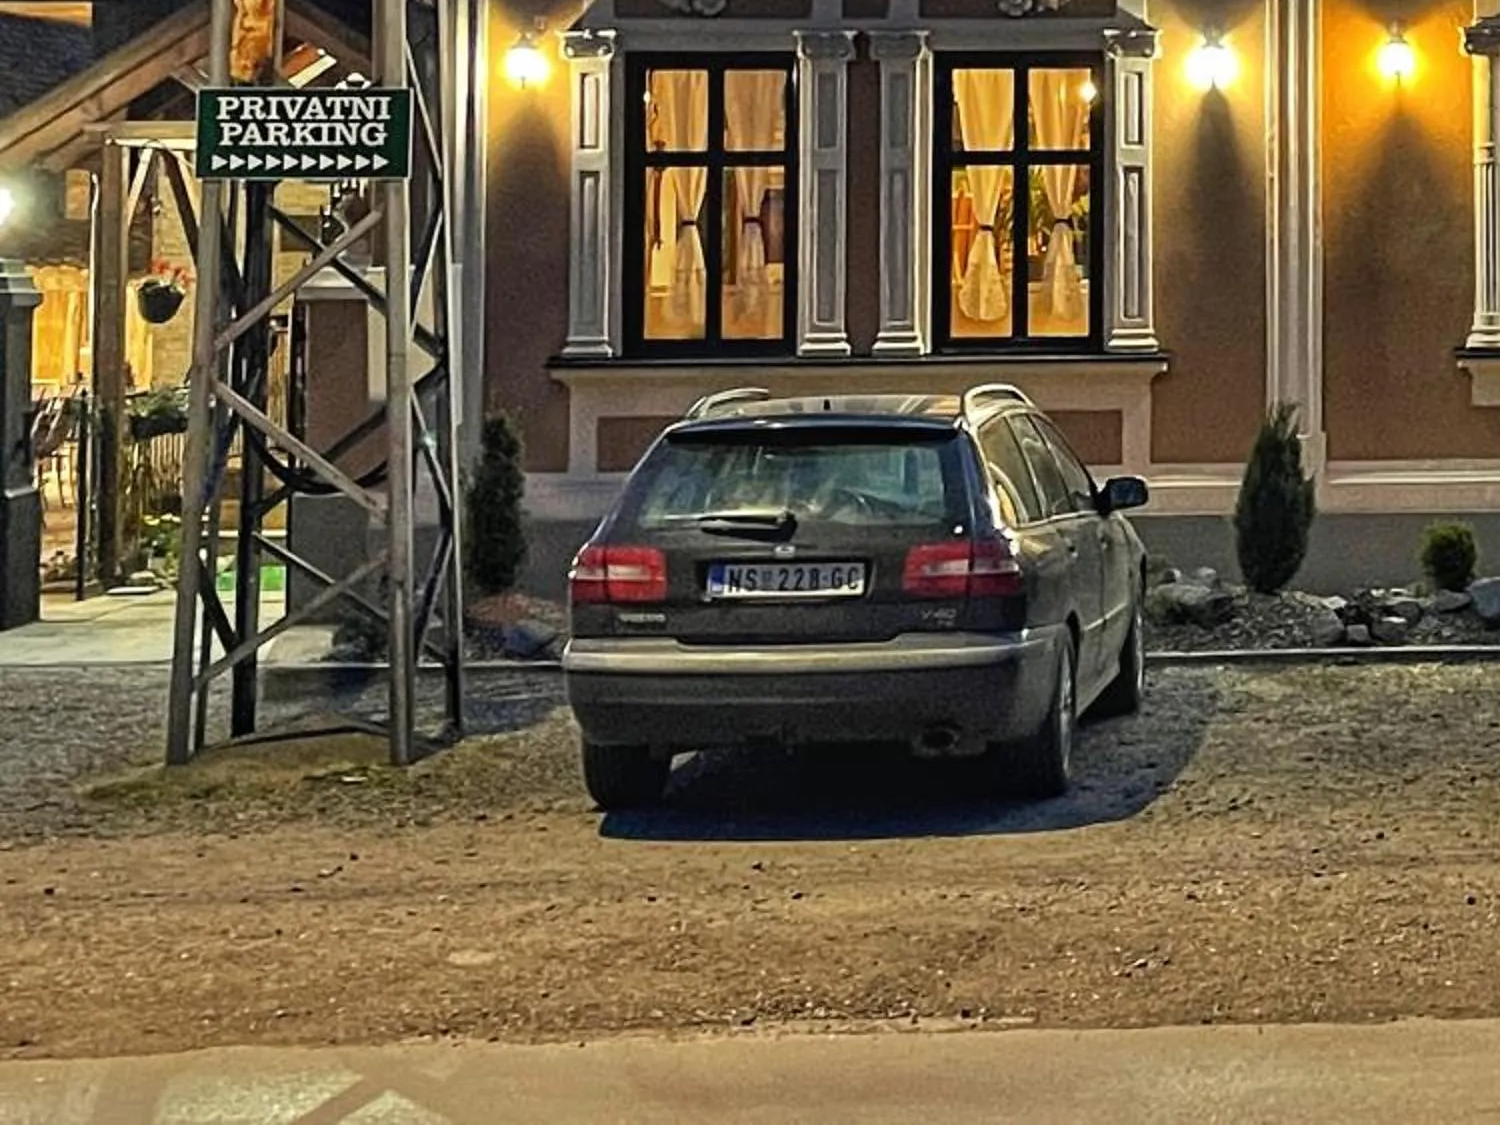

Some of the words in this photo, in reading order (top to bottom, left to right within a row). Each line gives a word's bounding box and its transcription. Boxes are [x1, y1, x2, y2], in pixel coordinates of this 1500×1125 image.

[216, 96, 392, 120] PRIVATNI
[219, 122, 388, 146] PARKING
[728, 567, 758, 594] NS
